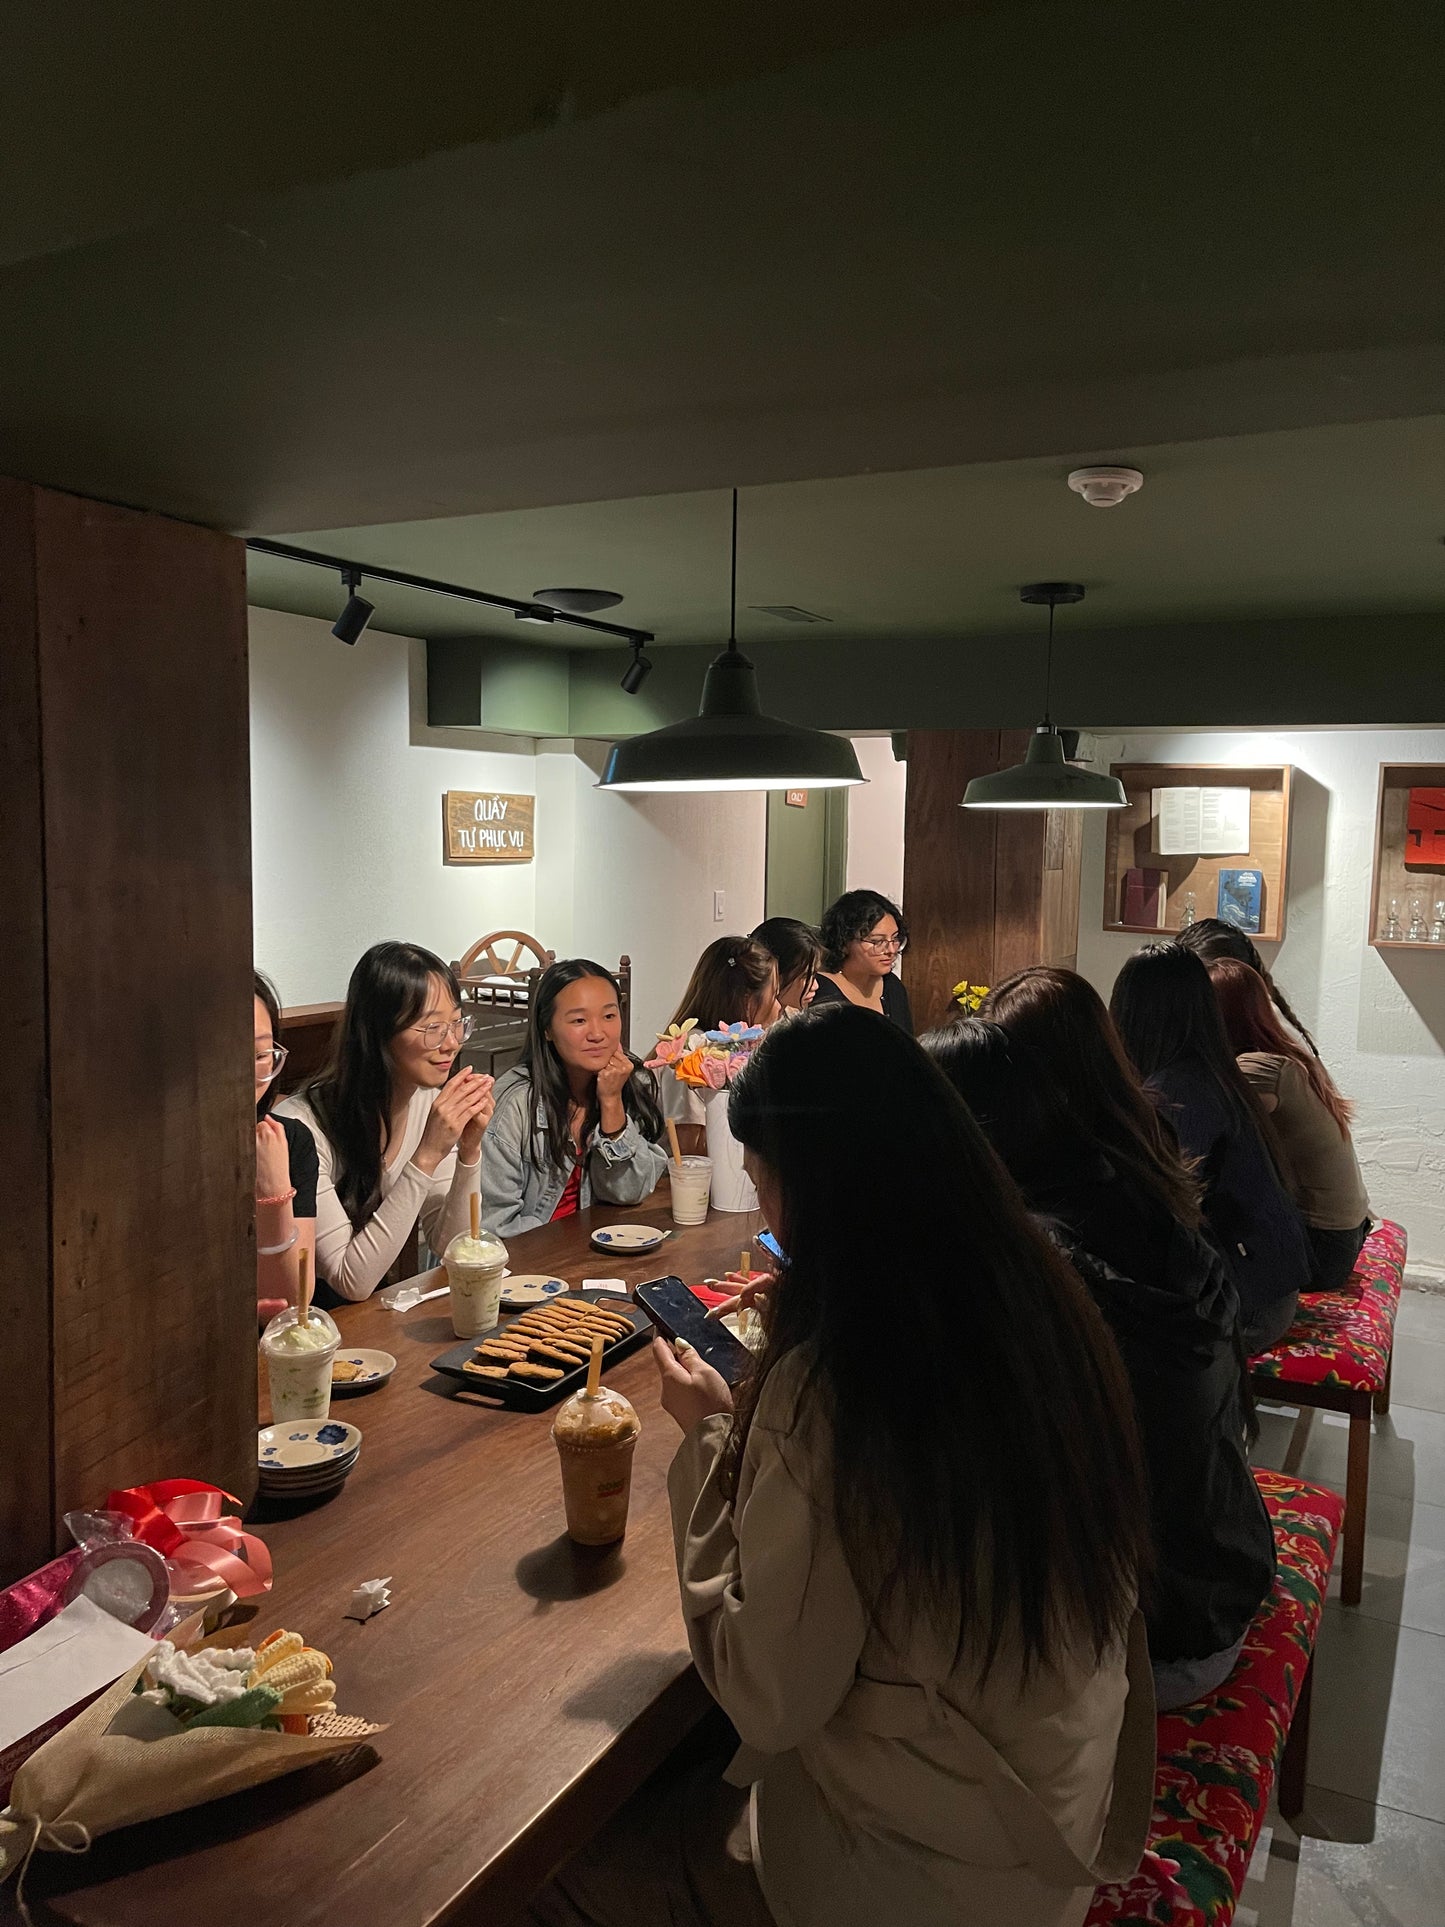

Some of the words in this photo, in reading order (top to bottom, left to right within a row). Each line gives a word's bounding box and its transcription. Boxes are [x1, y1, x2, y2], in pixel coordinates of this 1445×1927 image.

[474, 795, 508, 821] QUẦY
[458, 827, 477, 852] TỰ
[479, 829, 507, 852] PHỤC
[508, 830, 524, 852] VỤ
